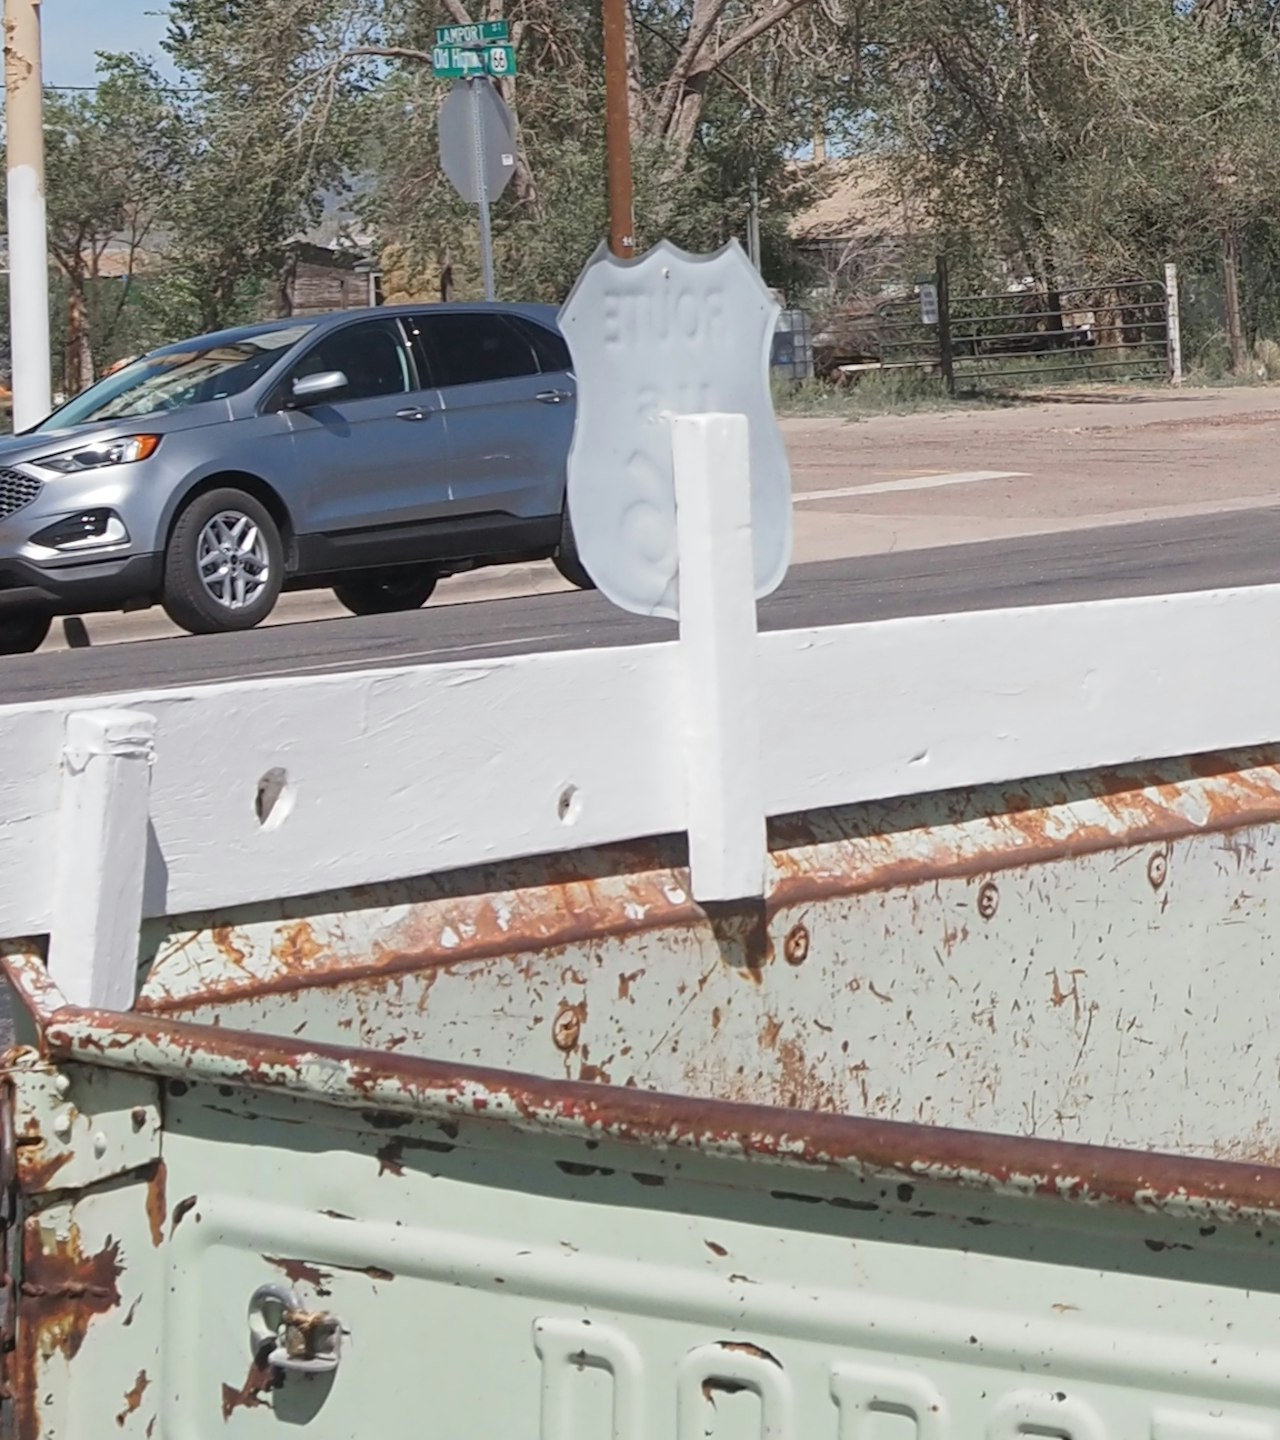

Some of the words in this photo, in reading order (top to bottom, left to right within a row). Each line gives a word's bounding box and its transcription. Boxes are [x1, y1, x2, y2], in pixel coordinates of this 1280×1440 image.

[436, 24, 484, 45] LAMPORT
[434, 48, 449, 69] Old
[493, 51, 505, 68] 66
